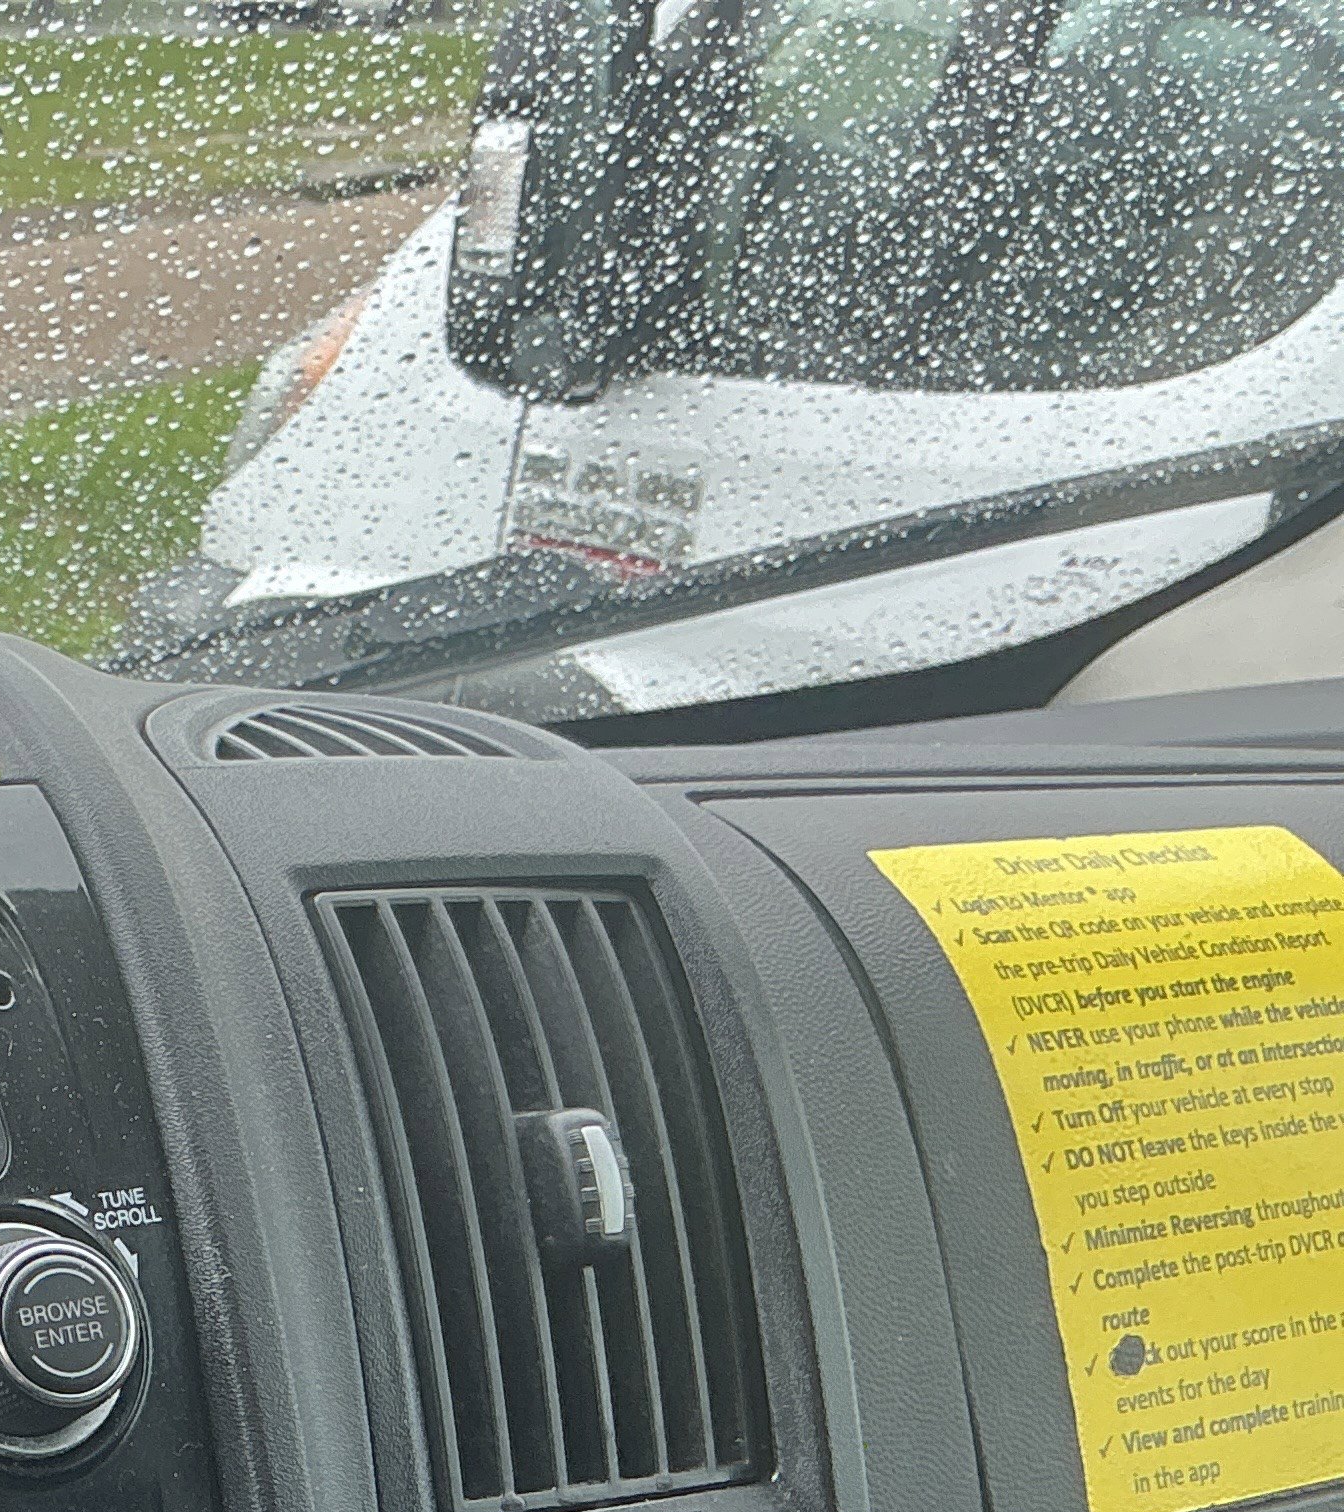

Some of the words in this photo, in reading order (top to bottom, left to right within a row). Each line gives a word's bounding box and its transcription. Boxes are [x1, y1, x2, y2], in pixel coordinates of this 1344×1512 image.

[994, 856, 1064, 875] Driver
[1063, 850, 1125, 872] Daily
[950, 895, 1002, 915] Login
[1001, 894, 1023, 911] to
[1103, 886, 1137, 904] app
[973, 926, 1018, 945] Scan
[1016, 922, 1050, 941] the
[1049, 919, 1080, 939] QR
[1079, 914, 1122, 935] code
[1122, 917, 1146, 931] on
[1145, 912, 1185, 933] your
[1185, 903, 1243, 925] vehicle
[1242, 900, 1274, 920] and
[993, 960, 1027, 980] the
[1027, 952, 1094, 982] pre-trip
[1092, 946, 1138, 970] Daily
[1134, 941, 1200, 964] Vehicle
[1198, 934, 1277, 958] Condition
[1274, 929, 1332, 953] Report
[1011, 989, 1076, 1021] (DVCR)
[1074, 985, 1134, 1012] before
[1134, 984, 1169, 1008] you
[1169, 977, 1211, 998] start
[1210, 972, 1240, 993] the
[1241, 967, 1296, 993] engine
[1026, 1027, 1089, 1053] NEVER
[1089, 1027, 1122, 1046] use
[1122, 1021, 1161, 1046] your
[1164, 1013, 1218, 1041] phone
[1218, 1005, 1264, 1029] while
[1264, 1002, 1294, 1024] the
[1043, 1065, 1114, 1092] moving,
[1113, 1060, 1134, 1082] in
[1135, 1053, 1193, 1081] traffic,
[1195, 1053, 1213, 1072] or
[1216, 1048, 1236, 1069] at
[1237, 1048, 1260, 1066] an
[1259, 1034, 1344, 1063] intersectio
[1051, 1108, 1097, 1130] Turn
[1097, 1100, 1127, 1124] Off
[1128, 1098, 1168, 1125] your
[1170, 1086, 1231, 1114] vehicle
[1232, 1085, 1251, 1105] at
[1252, 1081, 1297, 1103] every
[1298, 1076, 1335, 1098] stop
[1064, 1146, 1094, 1170] DO
[1096, 1140, 1137, 1165] NOT
[1137, 1136, 1187, 1159] leave
[1188, 1127, 1219, 1151] the
[1218, 1123, 1258, 1149] keys
[1257, 1113, 1308, 1140] inside
[1308, 1110, 1338, 1132] the
[96, 1186, 148, 1210] TUNE
[1074, 1190, 1109, 1217] you
[1113, 1184, 1150, 1206] step
[1153, 1168, 1218, 1199] outside
[92, 1205, 163, 1231] SCROLL
[1084, 1218, 1168, 1251] Minimize
[1169, 1204, 1256, 1237] Reversing
[1093, 1259, 1180, 1291] Complete
[1181, 1250, 1212, 1275] the
[1214, 1238, 1287, 1276] post-trip
[1287, 1229, 1335, 1256] DVCR
[17, 1294, 112, 1328] BROWSE
[34, 1320, 106, 1350] ENTER
[1101, 1306, 1151, 1332] route
[1166, 1337, 1198, 1362] out
[1199, 1331, 1238, 1361] your
[1241, 1322, 1288, 1348] score
[1288, 1315, 1307, 1338] in
[1308, 1309, 1338, 1334] the
[1116, 1385, 1176, 1414] events
[1177, 1377, 1205, 1402] for
[1206, 1371, 1237, 1397] the
[1239, 1365, 1271, 1391] day
[1121, 1428, 1168, 1455] View
[1171, 1416, 1206, 1445] and
[1208, 1403, 1290, 1435] complete
[1292, 1389, 1344, 1420] trainin
[1132, 1471, 1151, 1495] in
[1153, 1465, 1185, 1490] the
[1188, 1460, 1221, 1486] app
